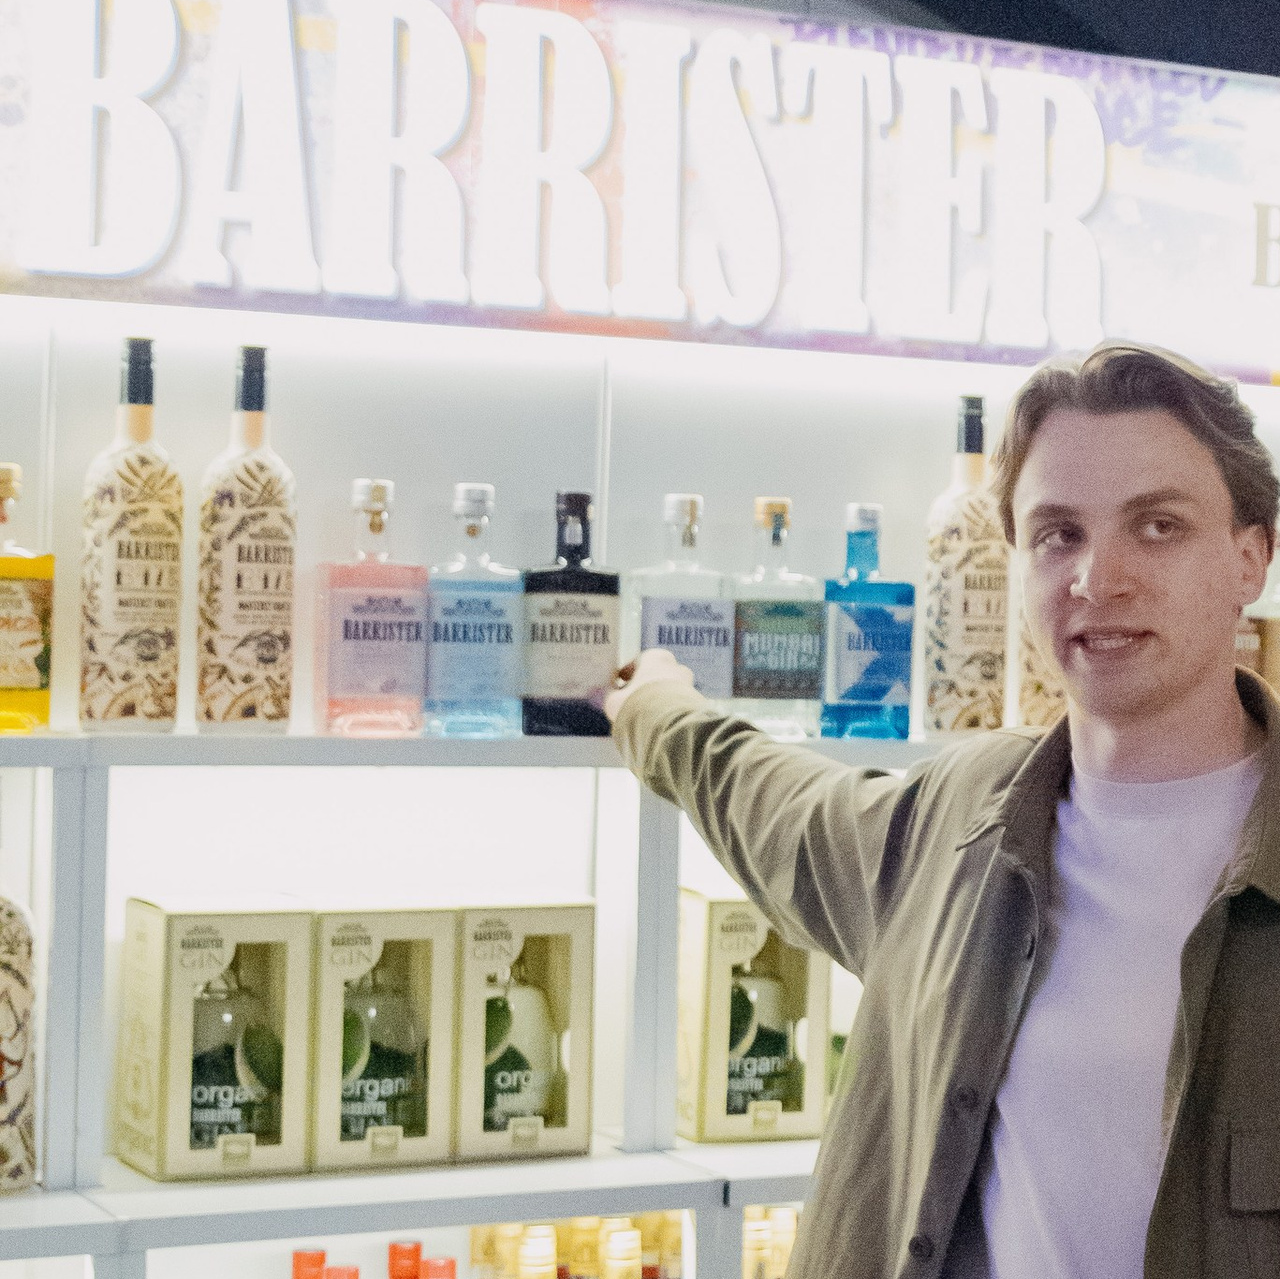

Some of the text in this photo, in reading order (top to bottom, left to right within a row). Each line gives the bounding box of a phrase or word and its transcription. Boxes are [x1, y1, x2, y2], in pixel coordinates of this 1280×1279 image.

[343, 620, 421, 641] BARRISTER
[432, 623, 513, 643] BARRISTER
[531, 622, 610, 644] BARRISTER
[658, 624, 730, 646] BARRISTER
[342, 1077, 410, 1102] organ
